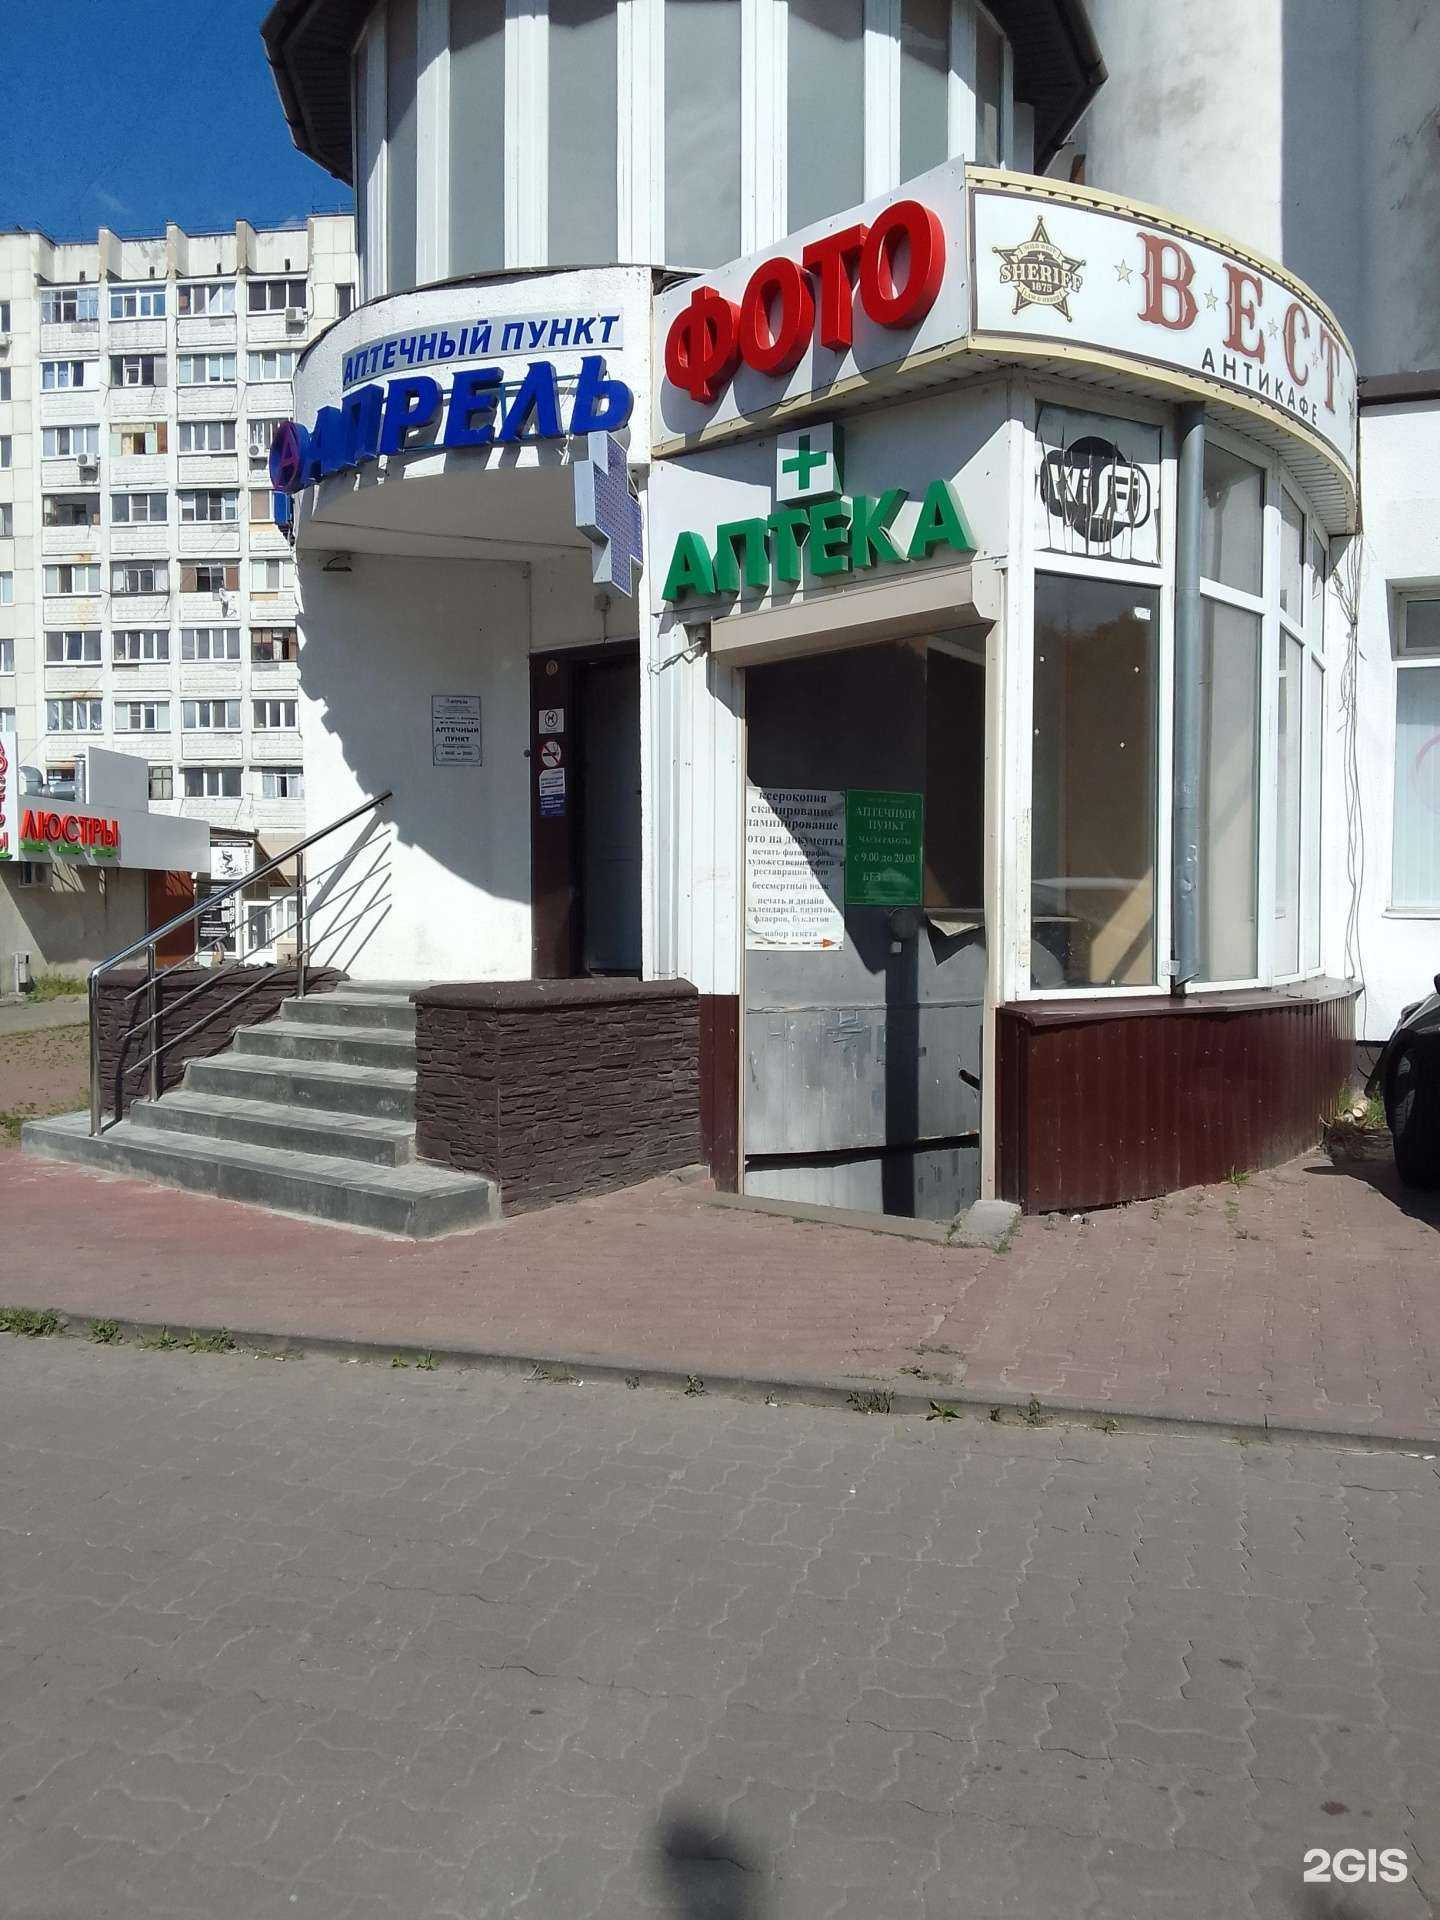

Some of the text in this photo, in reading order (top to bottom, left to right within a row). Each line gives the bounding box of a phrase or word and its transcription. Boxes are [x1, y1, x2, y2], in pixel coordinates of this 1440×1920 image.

[1000, 263, 1083, 293] SHERIFF
[665, 200, 946, 403] ФОТО
[1136, 232, 1340, 415] ВЕСТ
[343, 315, 620, 386] АПТЕЧНЫЙ ПУНКТ
[1201, 347, 1319, 426] АНТИКАФЕ
[312, 355, 634, 478] АПРЕЛЬ
[662, 479, 978, 600] АПТЕКА
[751, 805, 833, 818] сканирование
[759, 792, 828, 803] ксерокопия
[20, 809, 119, 848] ЛЮСТРЫ
[868, 819, 906, 831] ПУНКТ
[747, 835, 844, 847] ото на документы
[752, 881, 808, 891] бессмертный
[795, 897, 824, 906] дизайн
[764, 929, 788, 938] набор
